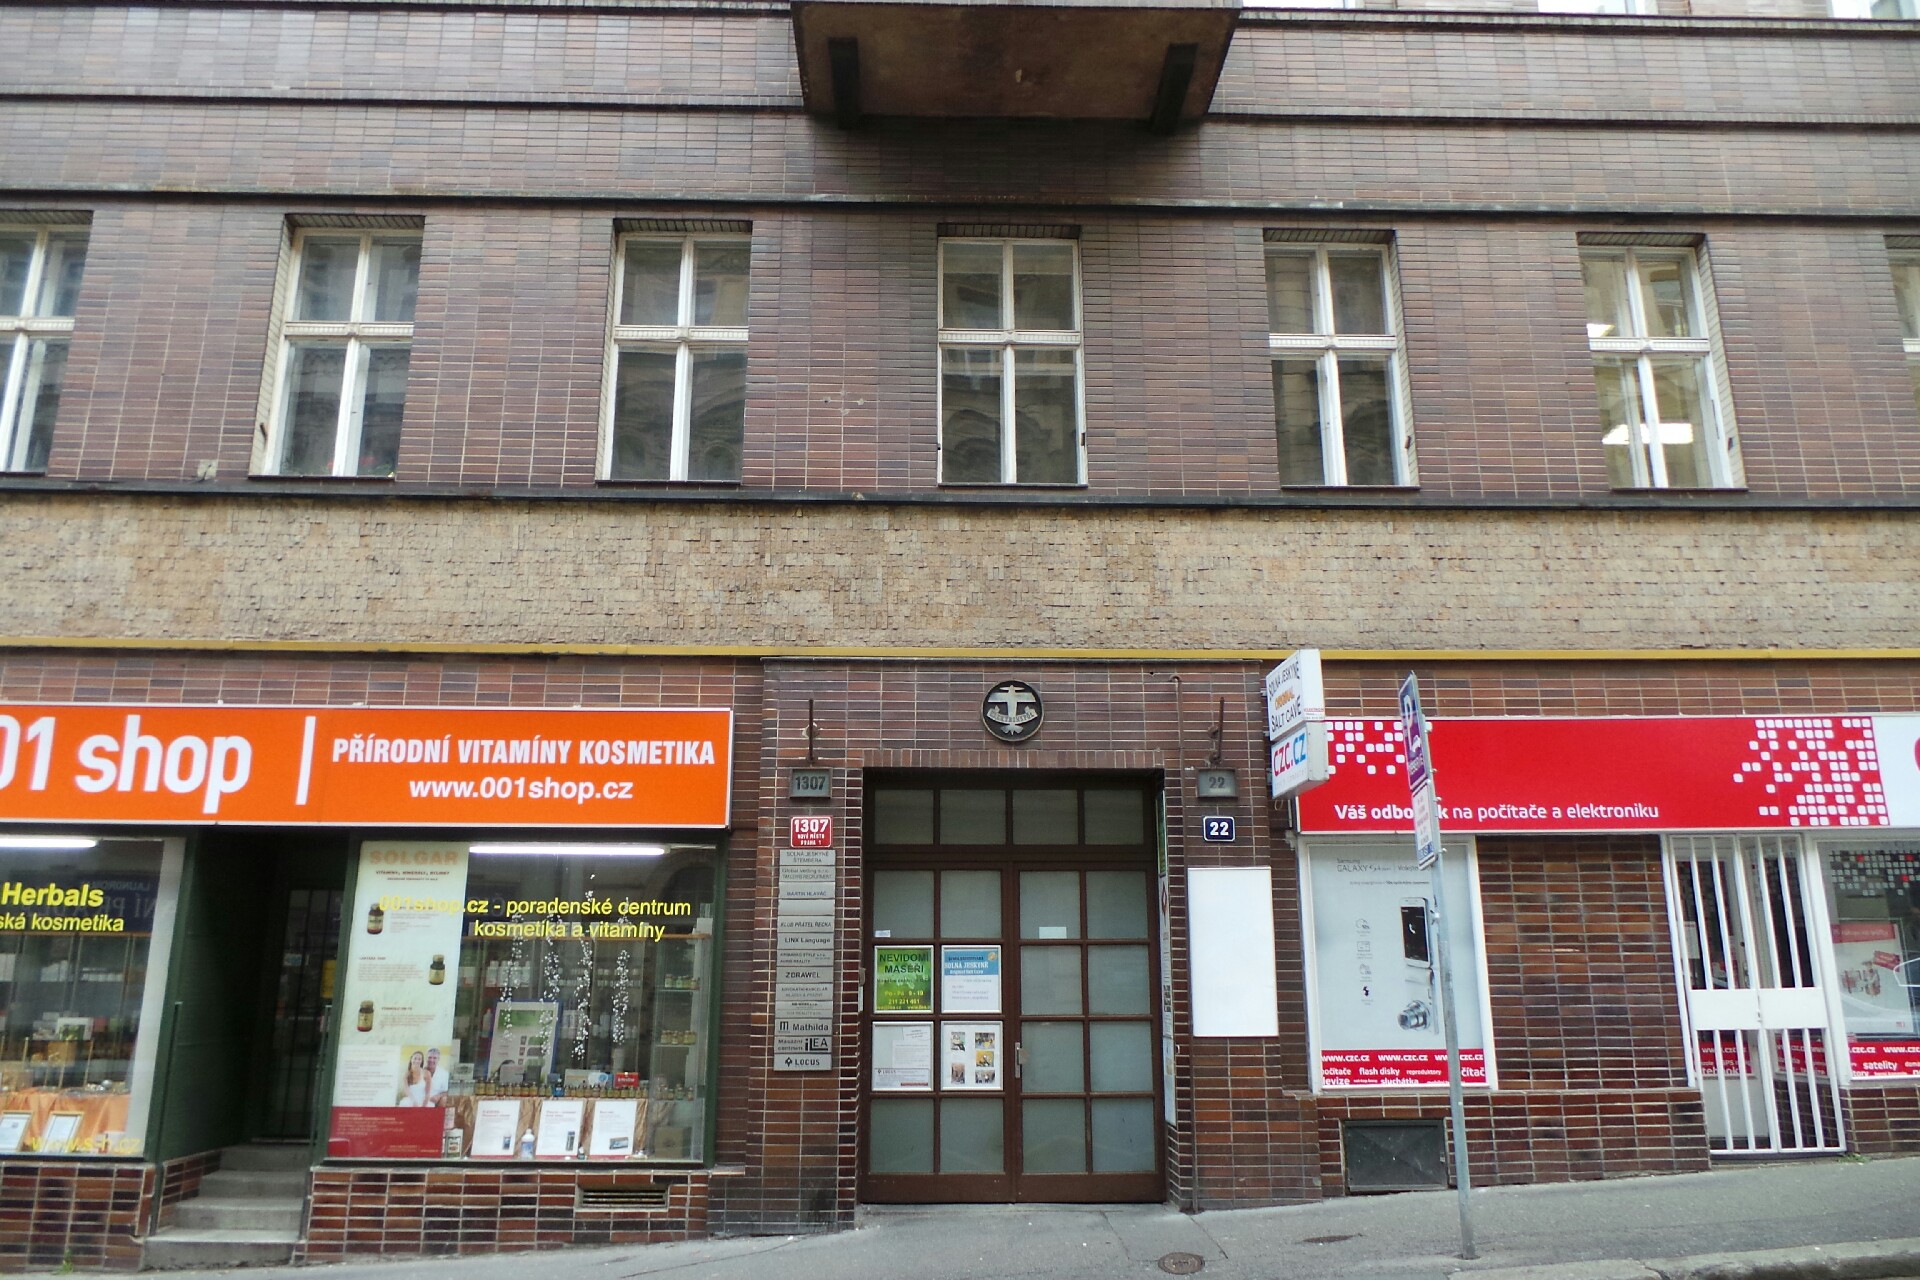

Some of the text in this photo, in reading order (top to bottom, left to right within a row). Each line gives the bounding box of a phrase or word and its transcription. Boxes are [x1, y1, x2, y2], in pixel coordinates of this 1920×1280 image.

[1271, 713, 1285, 733] SALT
[1286, 695, 1301, 722] CAVE
[332, 733, 715, 766] PŘÍRODNÍ VITAMÍNY KOSMETIKA
[74, 714, 253, 814] shop
[409, 776, 633, 805] www.001shop.cz
[795, 776, 826, 791] 1307
[1208, 776, 1225, 789] 22
[1334, 802, 1659, 823] Váš odbok na počítače a elektroniku
[794, 819, 829, 833] 1307
[1209, 821, 1229, 836] 22
[370, 849, 459, 866] SOLGAR
[1337, 864, 1368, 872] GALAXY
[1, 881, 104, 908] Herbals
[378, 896, 489, 918] 001shop.cz
[506, 897, 613, 920] poradenské
[617, 899, 691, 916] centrum
[31, 912, 125, 932] kosmetika
[473, 919, 566, 938] kosmetika
[589, 921, 666, 942] vitamíny
[792, 1023, 829, 1031] Mathilda
[794, 1058, 820, 1066] LOCUS
[1862, 1061, 1898, 1071] satelity
[1359, 1067, 1378, 1075] flash
[1380, 1067, 1401, 1077] disky
